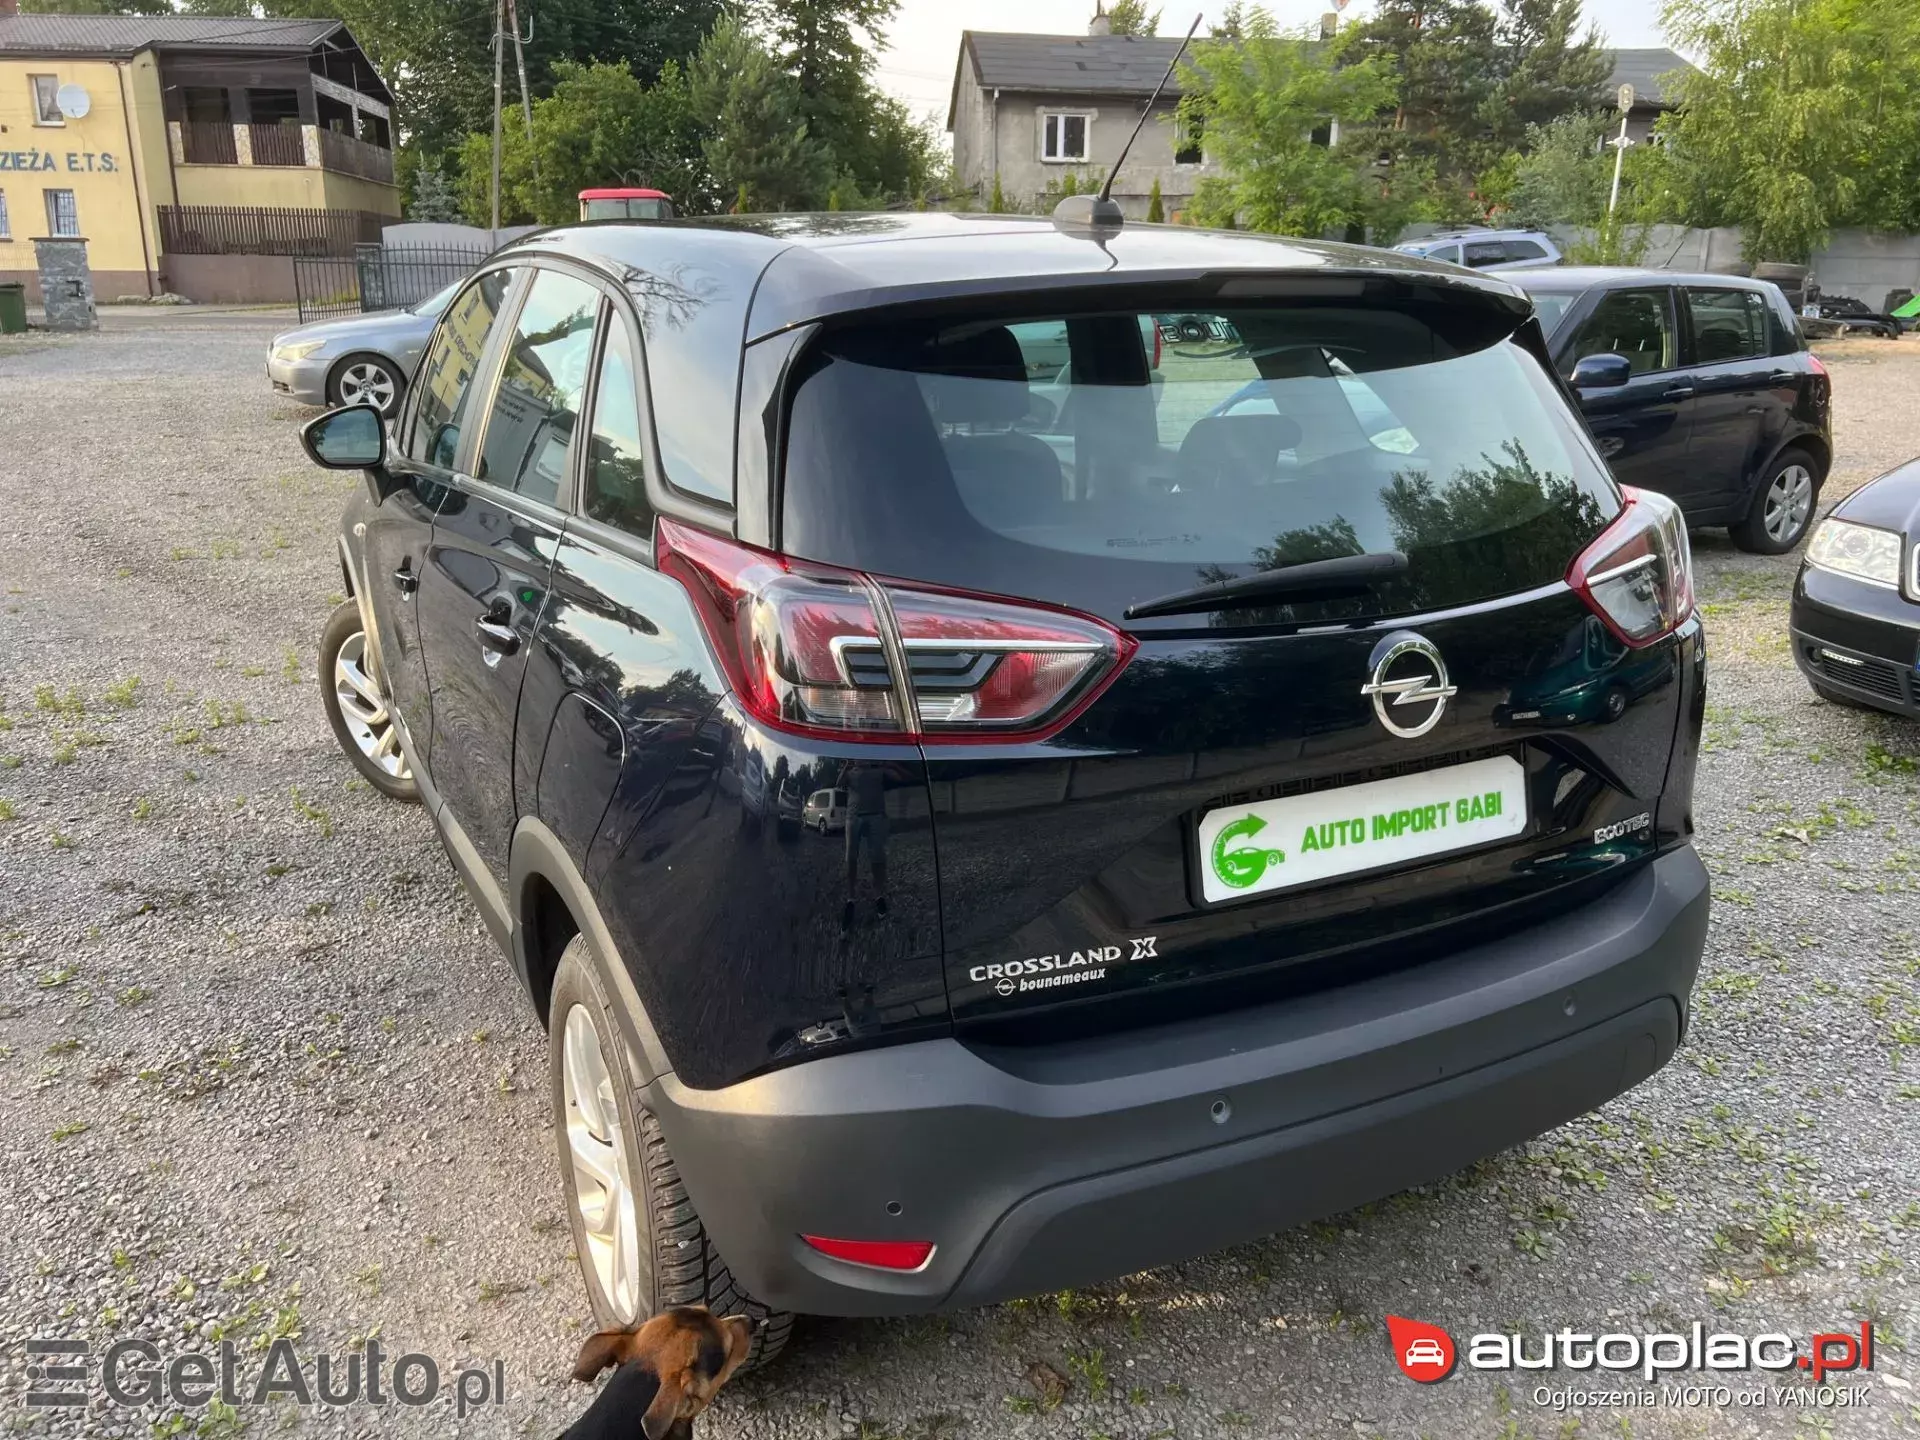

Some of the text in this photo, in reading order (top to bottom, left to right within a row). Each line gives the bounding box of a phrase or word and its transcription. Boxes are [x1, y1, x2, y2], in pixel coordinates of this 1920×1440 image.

[66, 152, 119, 173] E.T.S.
[1300, 791, 1502, 853] AUTO IMPORT GABI
[1594, 812, 1650, 845] ECOTEC
[969, 936, 1158, 982] CROSSLAND X
[1019, 967, 1106, 992] bounameaux
